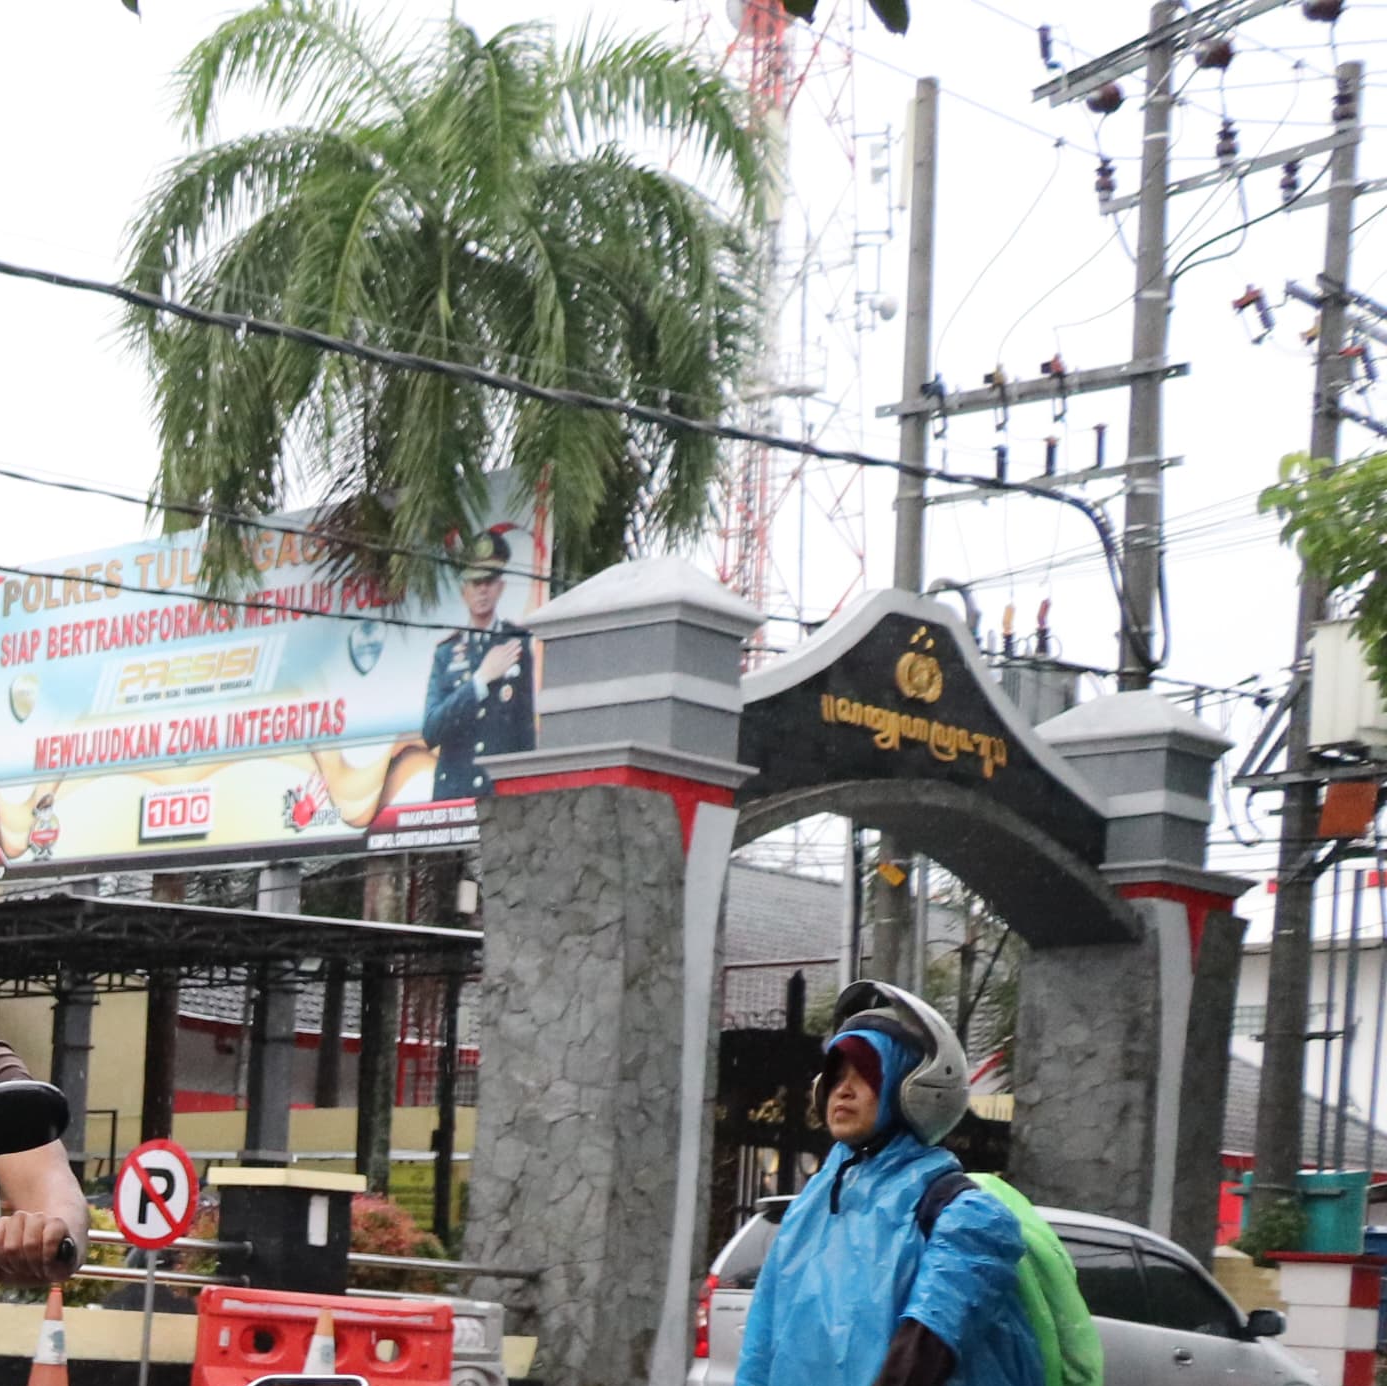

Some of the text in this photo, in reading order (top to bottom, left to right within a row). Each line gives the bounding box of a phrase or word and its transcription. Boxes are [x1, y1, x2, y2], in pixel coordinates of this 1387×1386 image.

[2, 559, 123, 617] POLRES
[0, 629, 42, 668] SIAP
[33, 697, 347, 772] MEWUJUDKAN ZONA INTEGRITAS
[148, 796, 210, 827] 110
